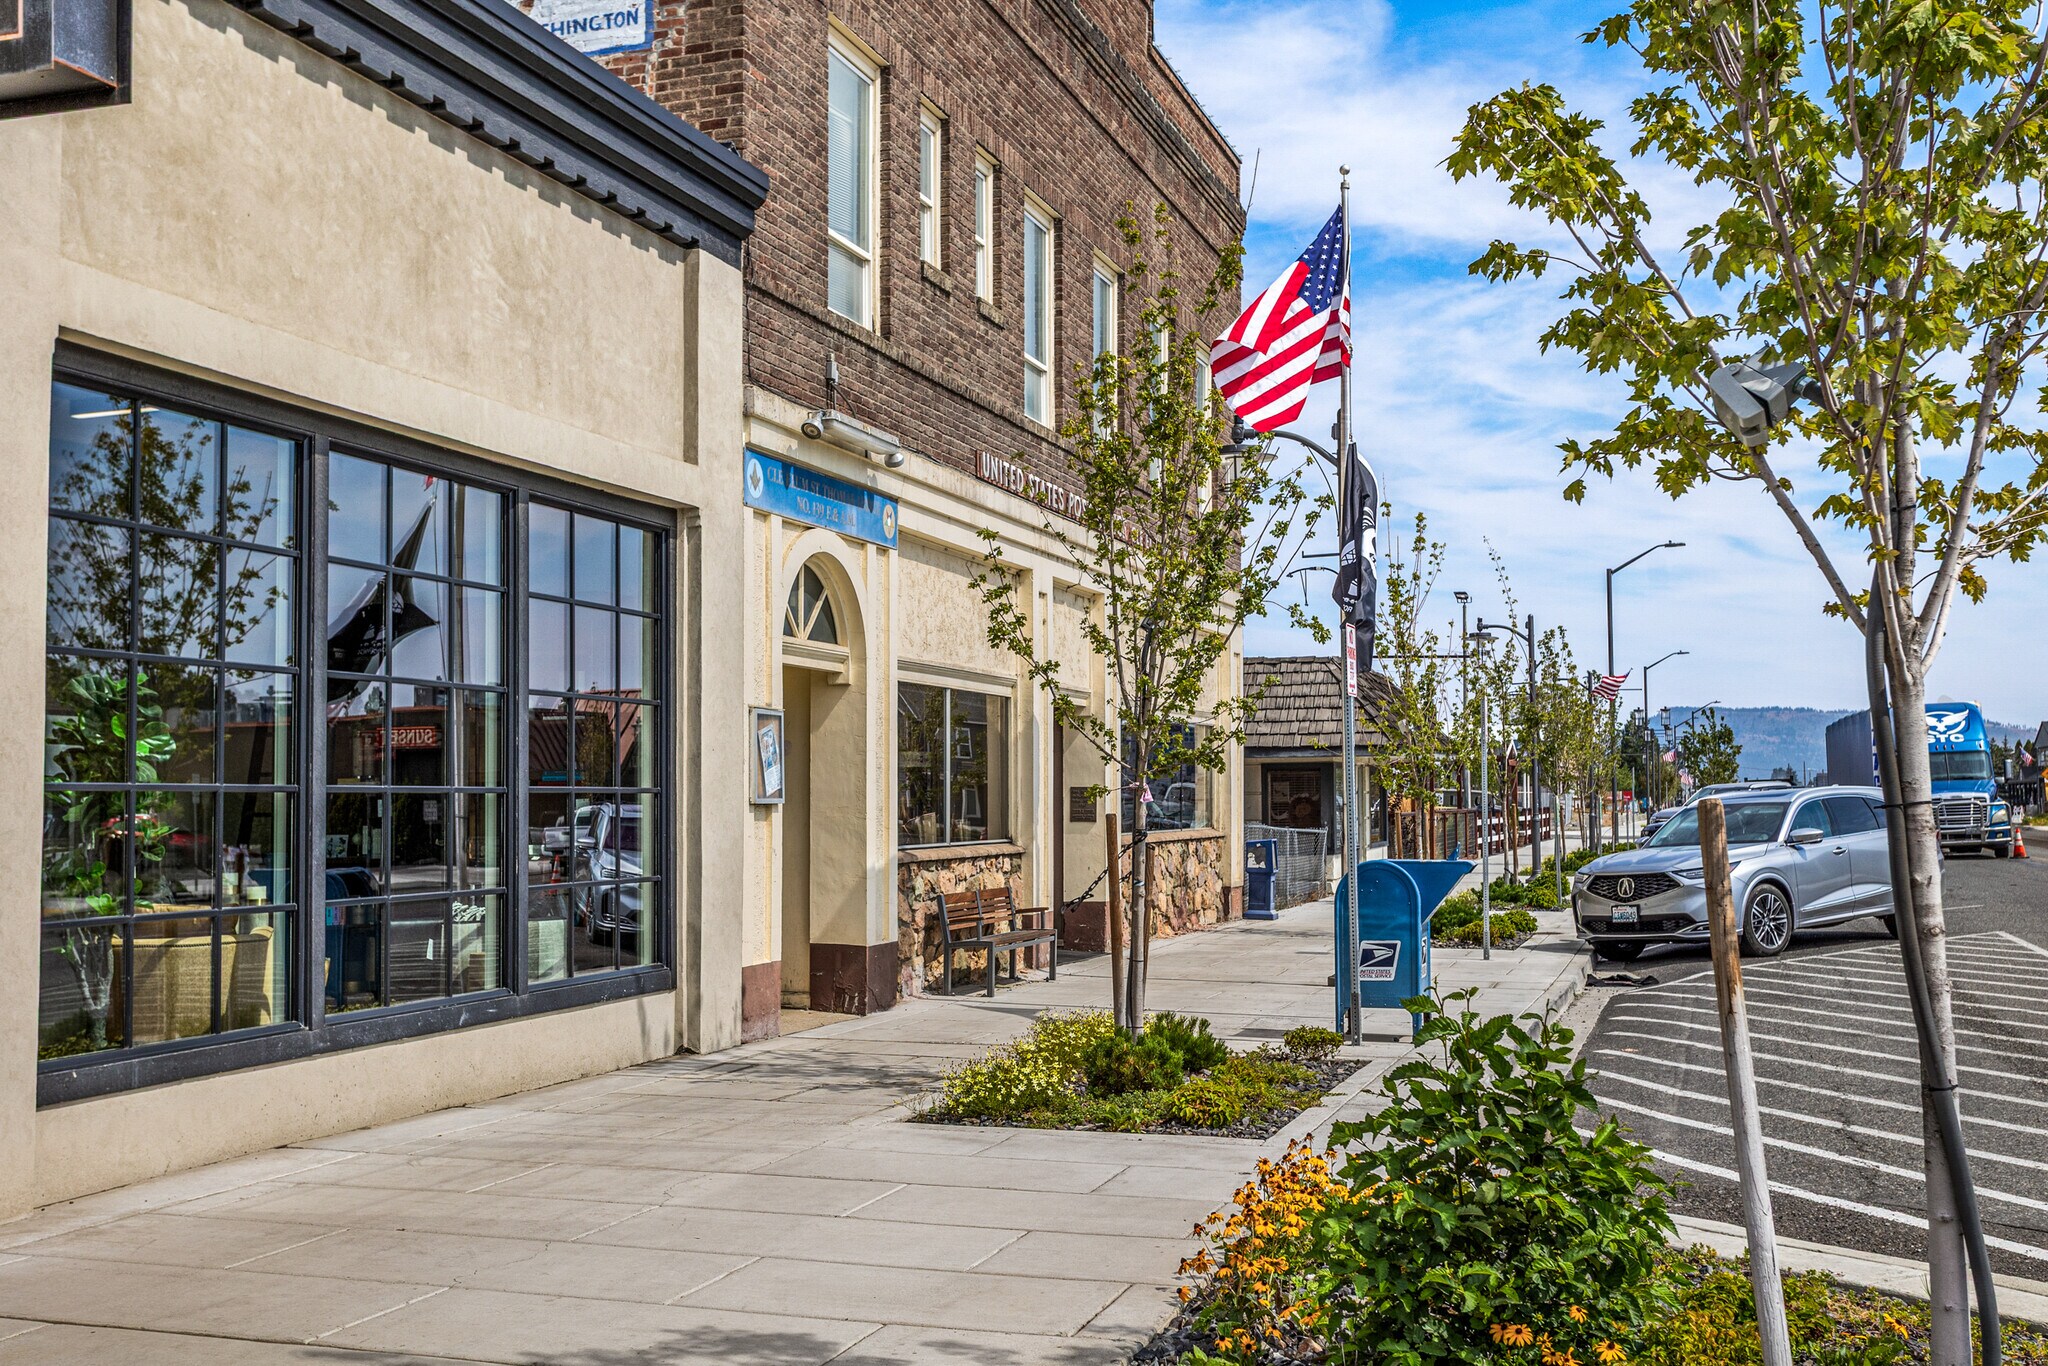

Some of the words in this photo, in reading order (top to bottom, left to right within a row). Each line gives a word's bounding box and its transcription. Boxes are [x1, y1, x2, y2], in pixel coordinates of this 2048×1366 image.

[543, 8, 639, 36] HINGTON
[767, 466, 784, 486] CLE
[982, 451, 1024, 493] UNITED
[1028, 474, 1065, 512] STATES
[1068, 491, 1091, 517] POS
